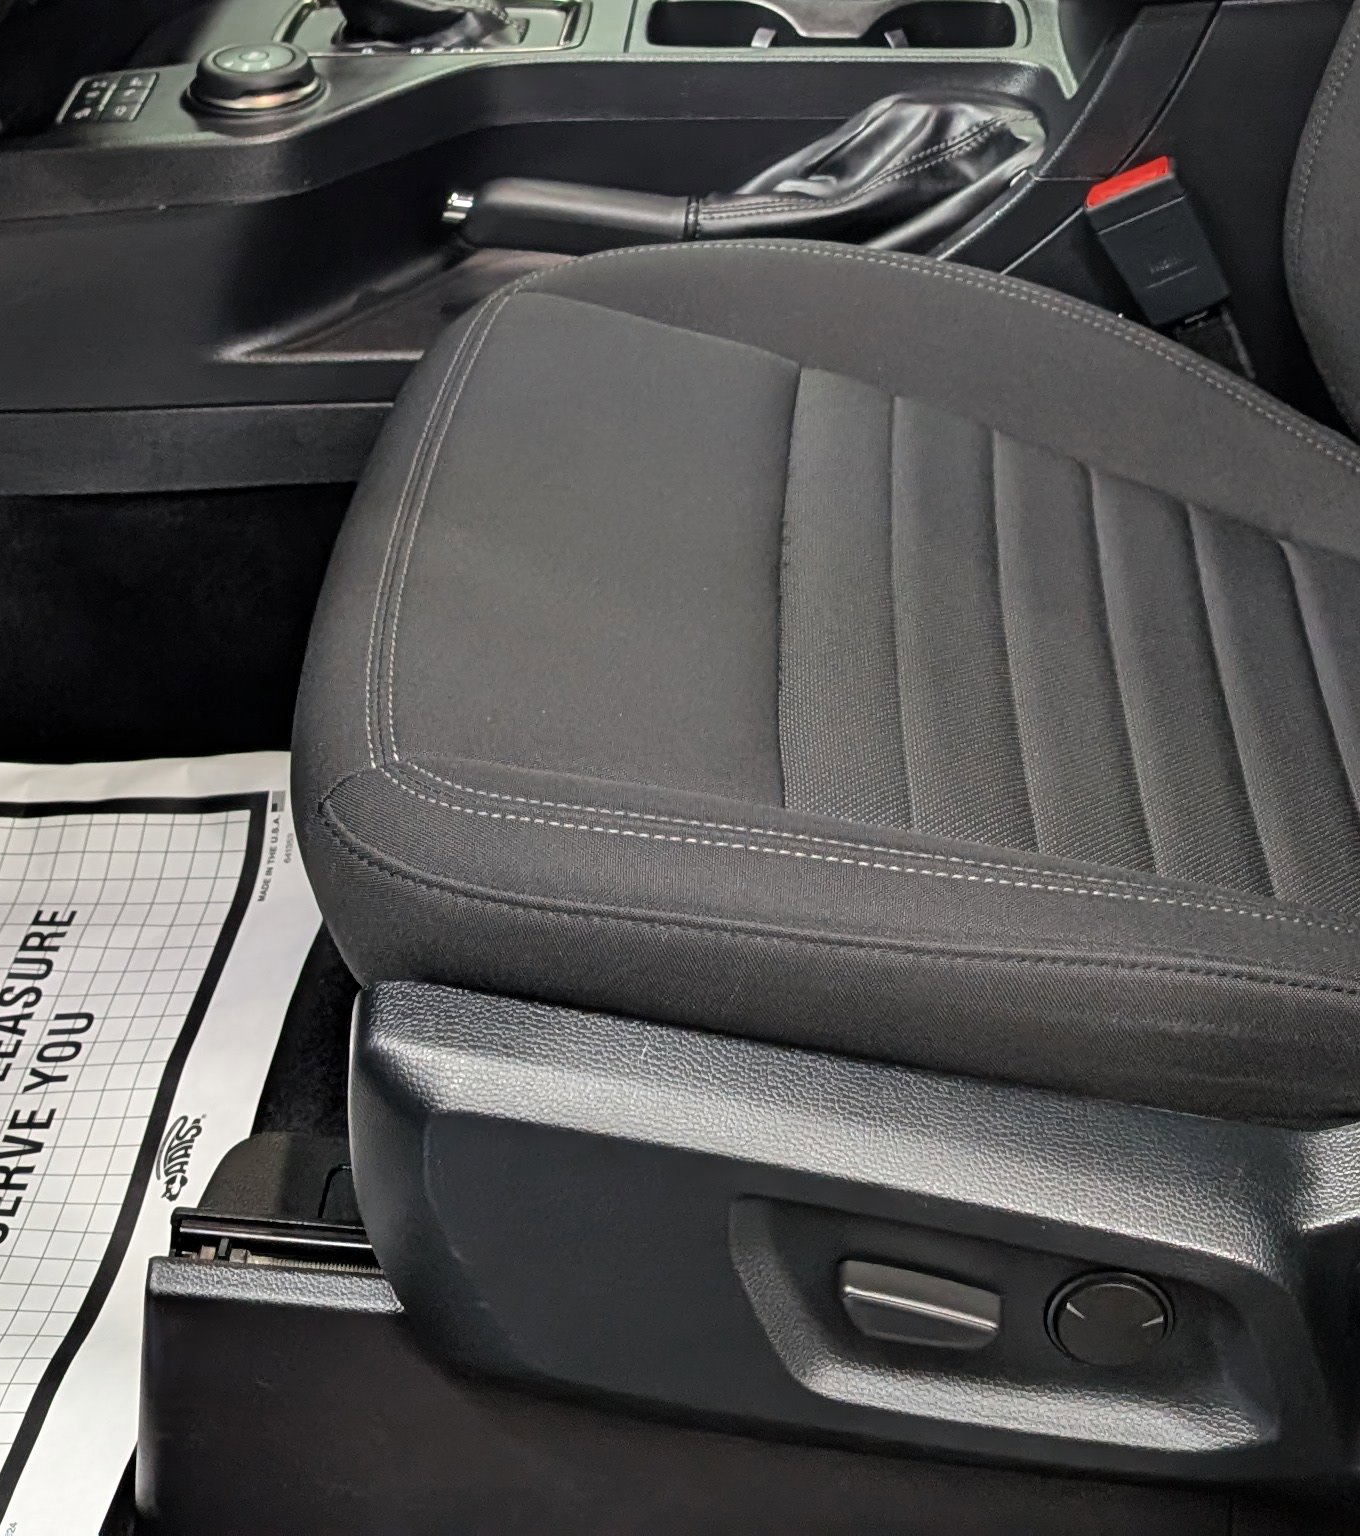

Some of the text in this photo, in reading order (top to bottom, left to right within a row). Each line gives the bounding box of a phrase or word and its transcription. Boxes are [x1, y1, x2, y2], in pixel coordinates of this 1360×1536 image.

[267, 846, 278, 865] THE
[265, 866, 274, 876] IN
[257, 877, 272, 902] MADE
[22, 1012, 94, 1092] YOU
